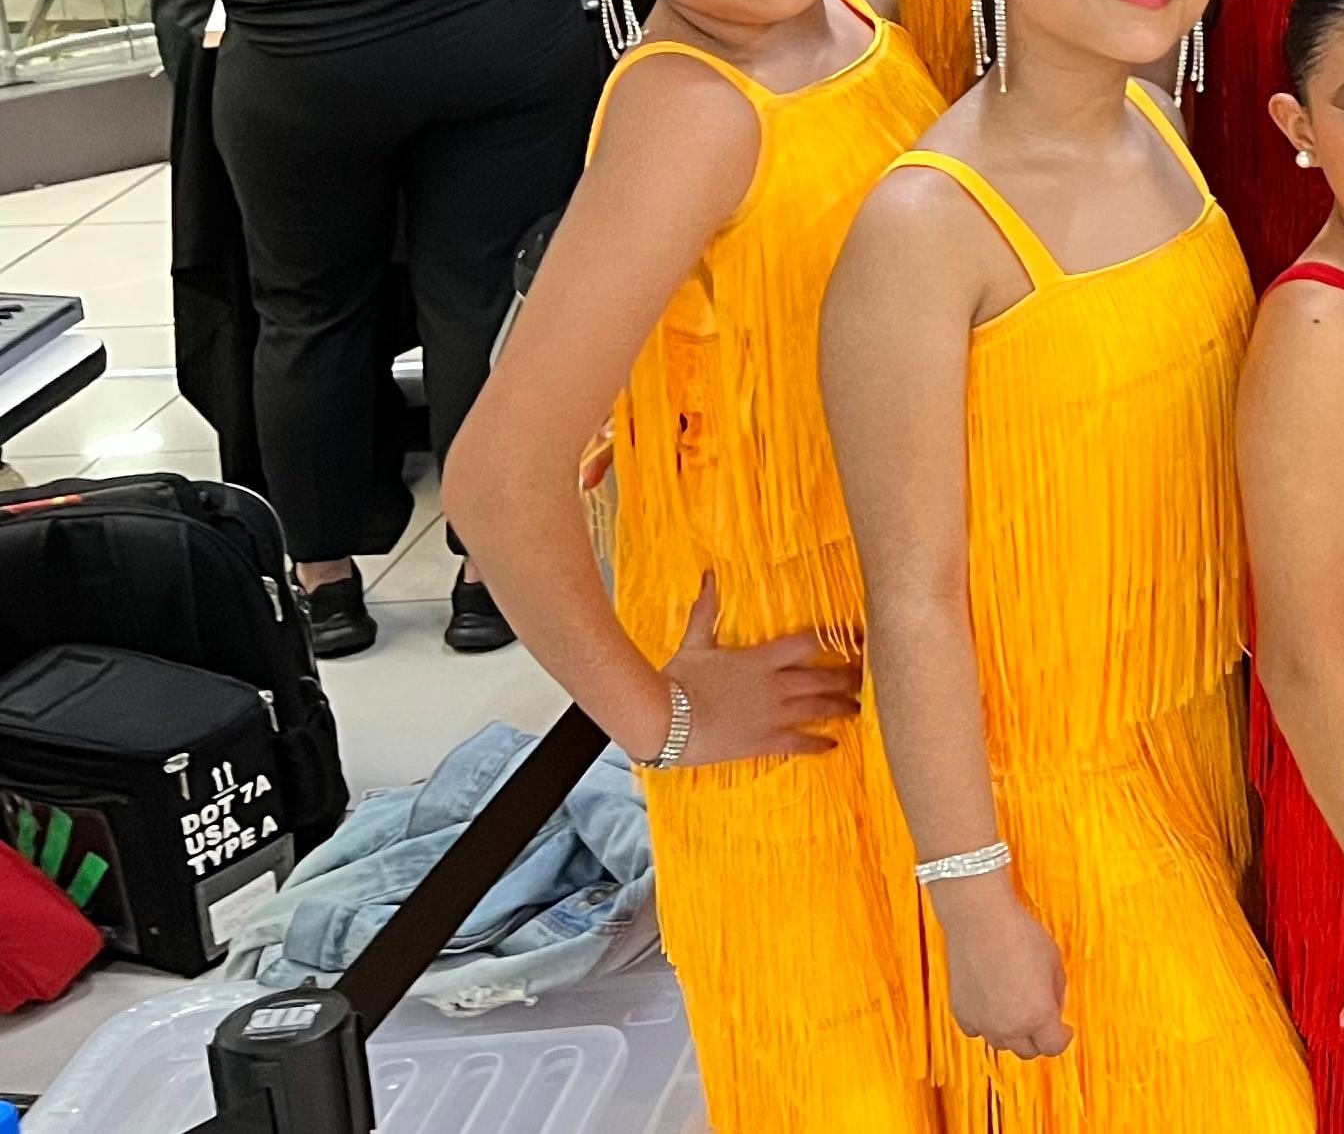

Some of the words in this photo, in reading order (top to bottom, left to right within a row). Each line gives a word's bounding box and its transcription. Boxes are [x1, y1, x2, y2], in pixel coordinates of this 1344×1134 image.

[181, 794, 236, 836] DOT
[240, 774, 272, 804] 7A
[185, 816, 241, 856] USA
[187, 827, 257, 876] TYPE
[261, 815, 279, 838] A
